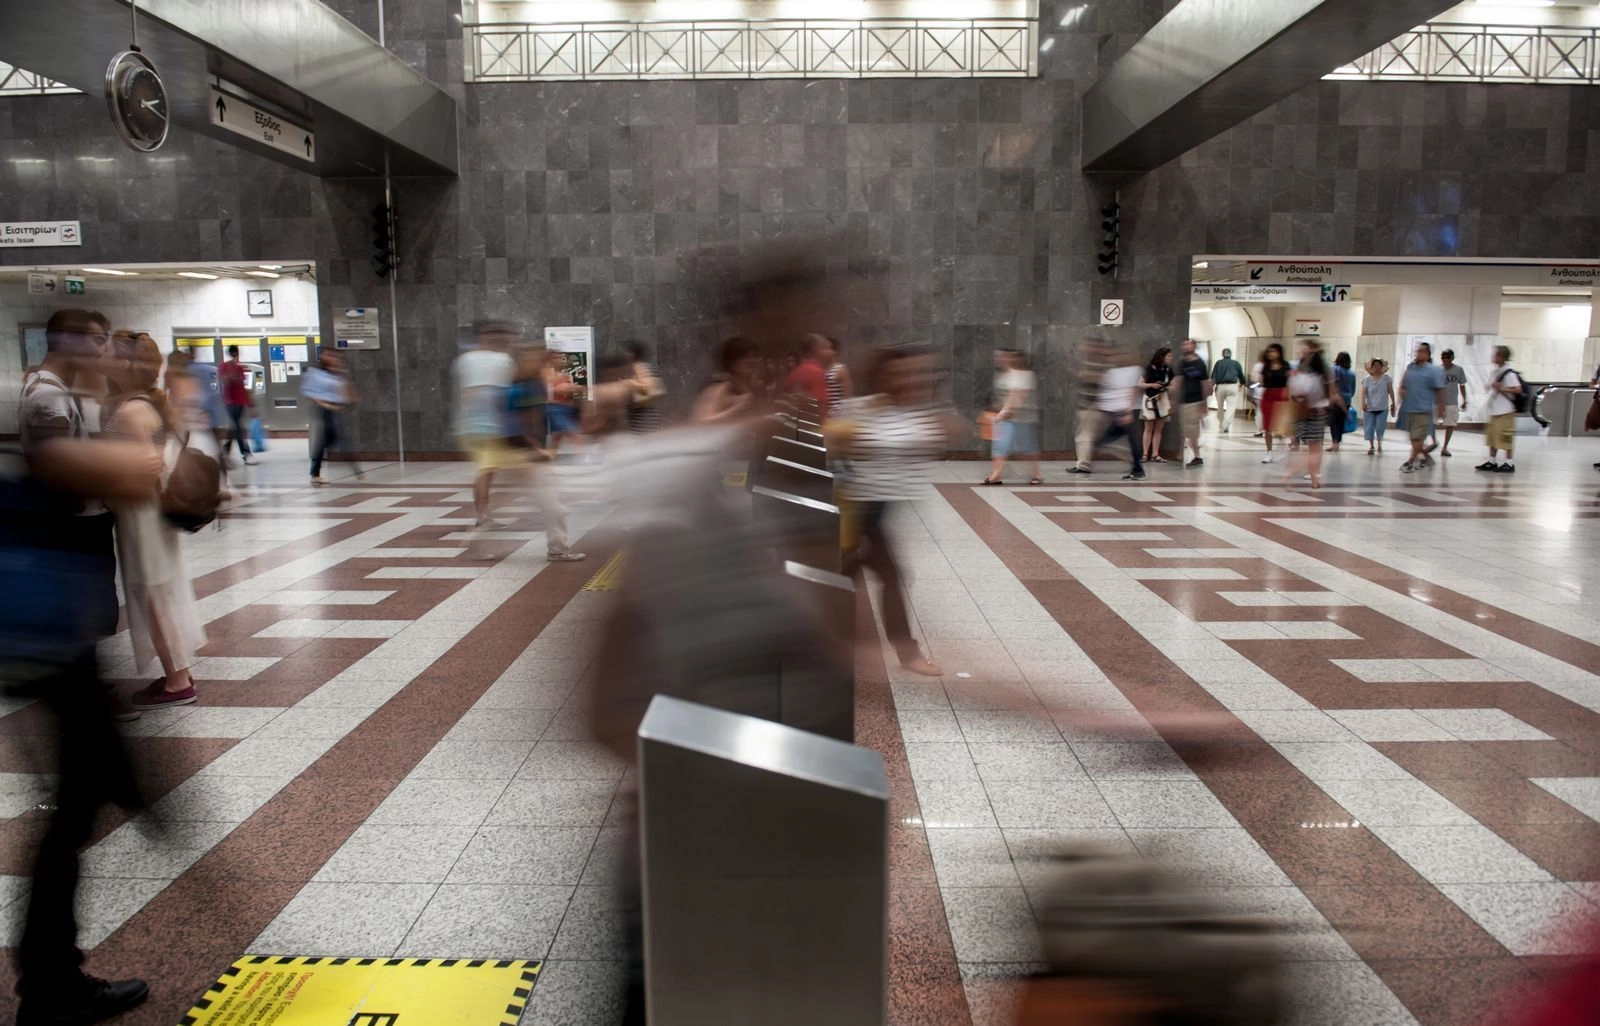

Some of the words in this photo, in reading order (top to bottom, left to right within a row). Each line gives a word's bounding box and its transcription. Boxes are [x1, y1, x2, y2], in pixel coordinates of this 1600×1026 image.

[264, 131, 274, 143] Exit
[5, 225, 57, 236] Εισιτηρίων
[1277, 265, 1332, 276] Ανθούπολη
[237, 971, 258, 990] having
[218, 995, 236, 1011] valid
